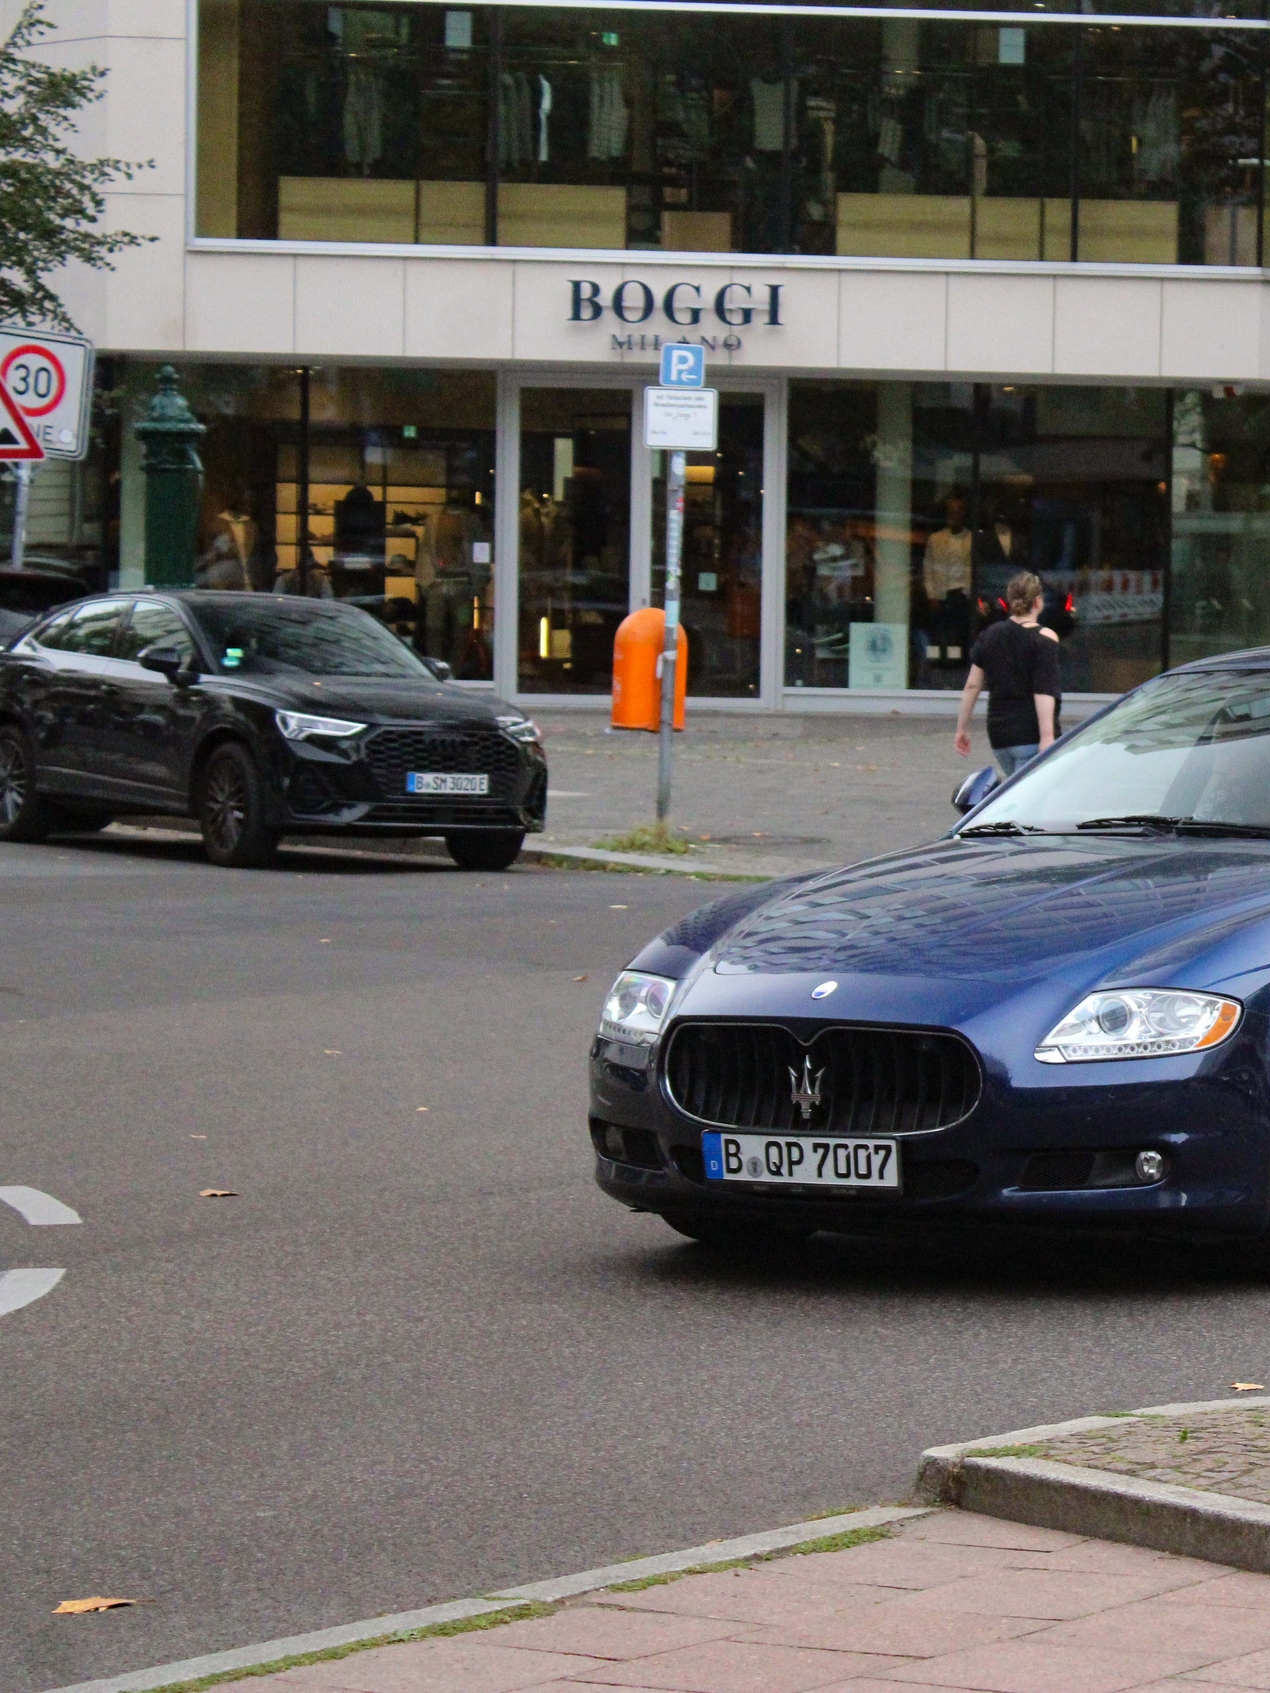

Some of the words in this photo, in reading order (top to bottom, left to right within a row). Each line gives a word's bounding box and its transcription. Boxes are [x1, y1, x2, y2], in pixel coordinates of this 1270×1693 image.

[566, 279, 785, 326] BOGGI
[12, 363, 52, 398] 30
[416, 775, 424, 790] B
[711, 1160, 718, 1171] D
[724, 1138, 743, 1174] B
[765, 1140, 804, 1177] QP
[812, 1142, 892, 1180] 7007
